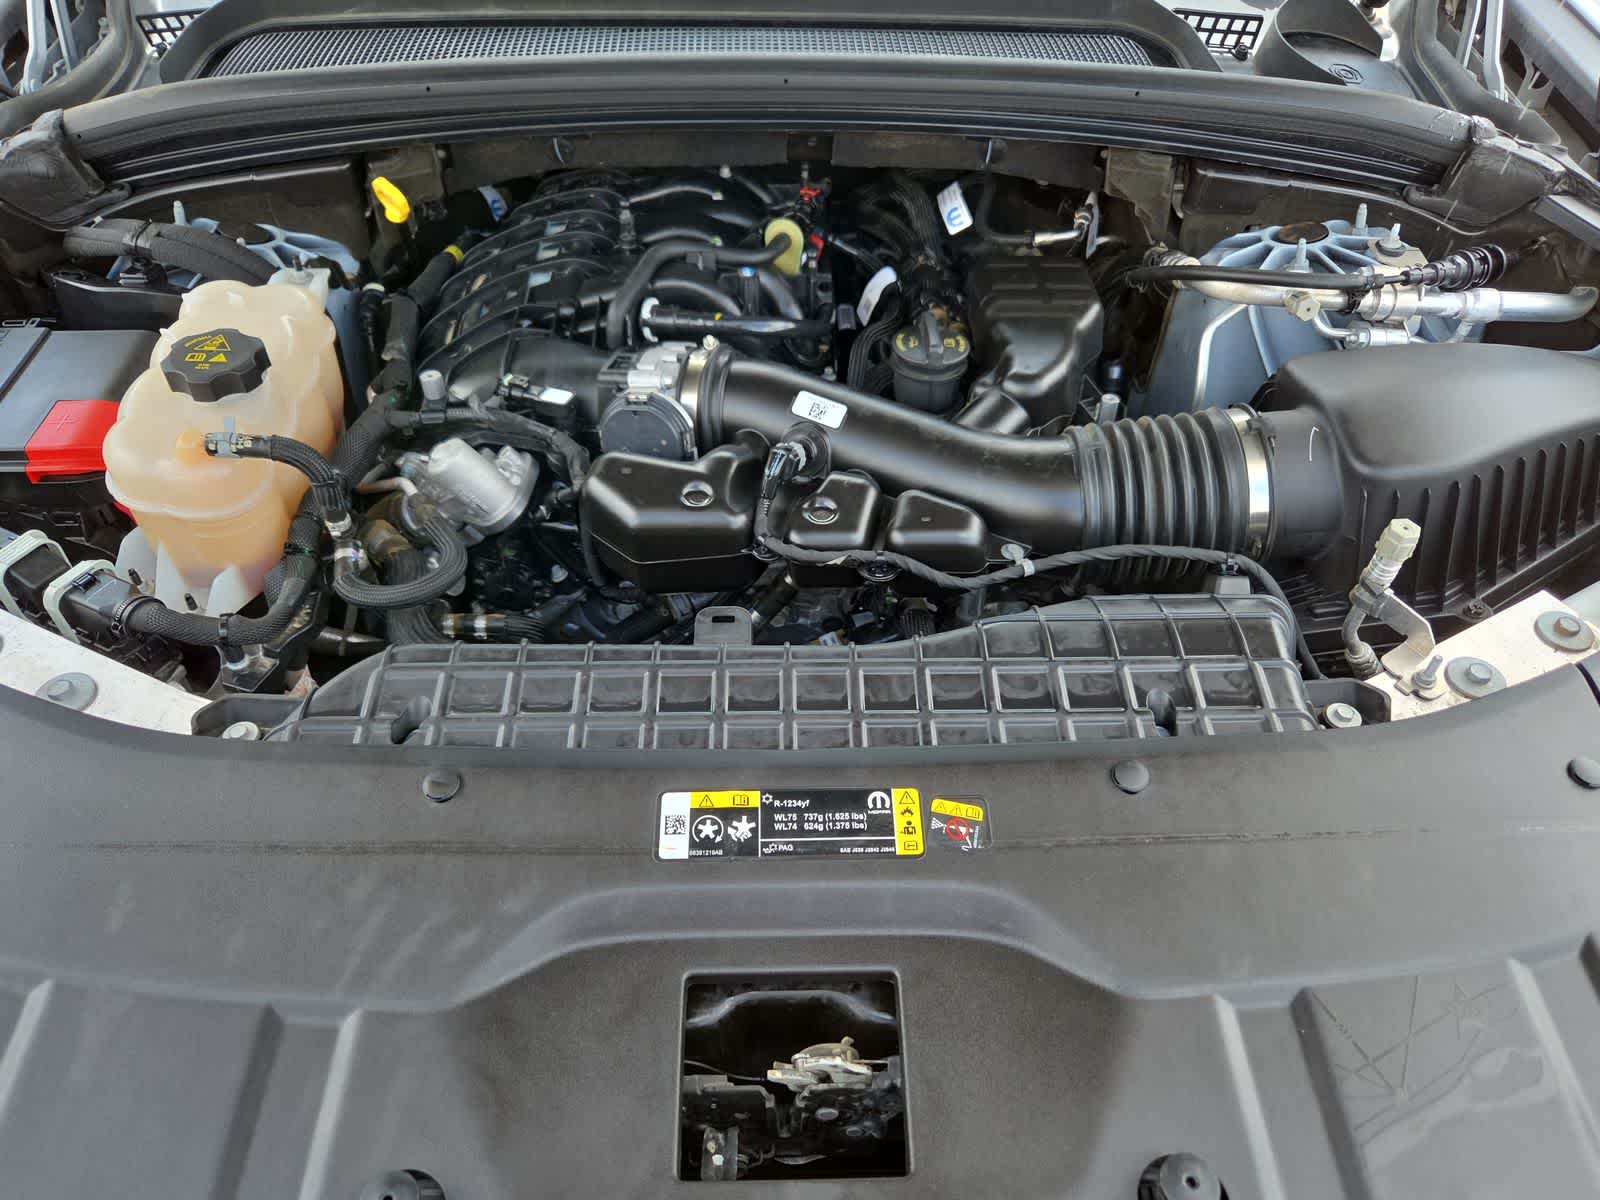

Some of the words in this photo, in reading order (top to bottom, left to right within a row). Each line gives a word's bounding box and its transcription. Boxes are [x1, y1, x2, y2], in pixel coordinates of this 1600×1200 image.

[774, 800, 810, 809] R-1234yf
[774, 813, 798, 822] WL75
[803, 813, 824, 823] 737g
[851, 812, 867, 822] lbs)
[774, 823, 798, 831] WL74
[803, 822, 824, 832] 624g
[825, 822, 850, 832] (1.375
[851, 822, 868, 832] lbs)
